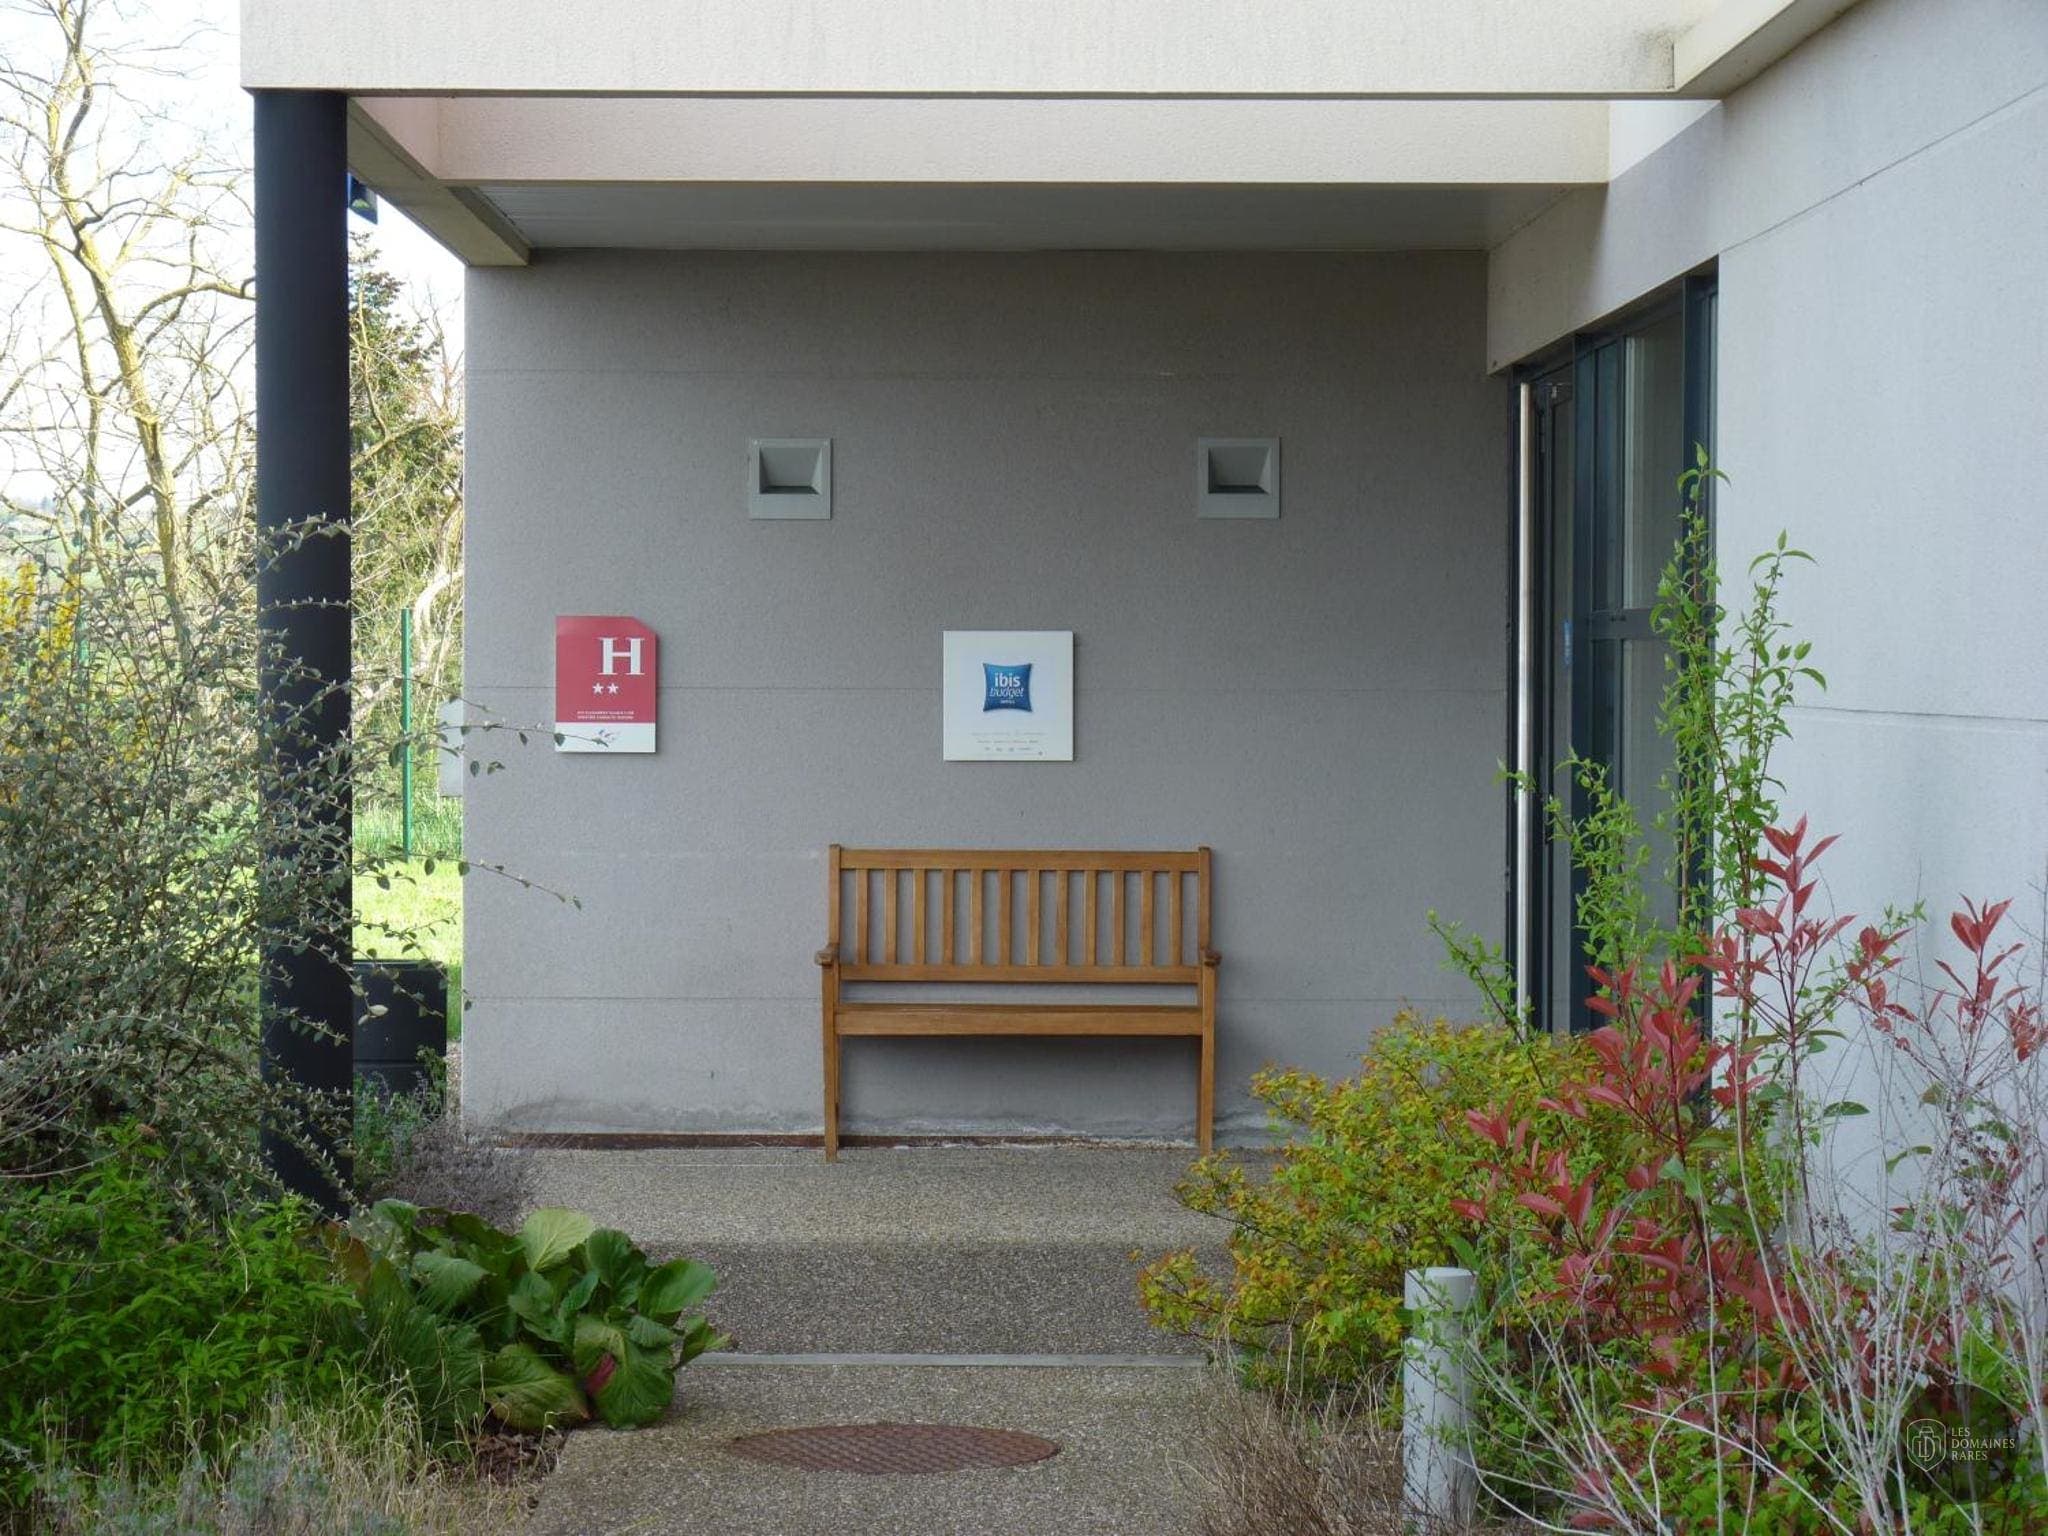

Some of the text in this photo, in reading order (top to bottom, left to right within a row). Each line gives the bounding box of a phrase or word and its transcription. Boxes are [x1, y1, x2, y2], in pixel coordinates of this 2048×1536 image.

[598, 637, 645, 675] H
[994, 672, 1021, 687] ibis
[989, 686, 1024, 699] budget
